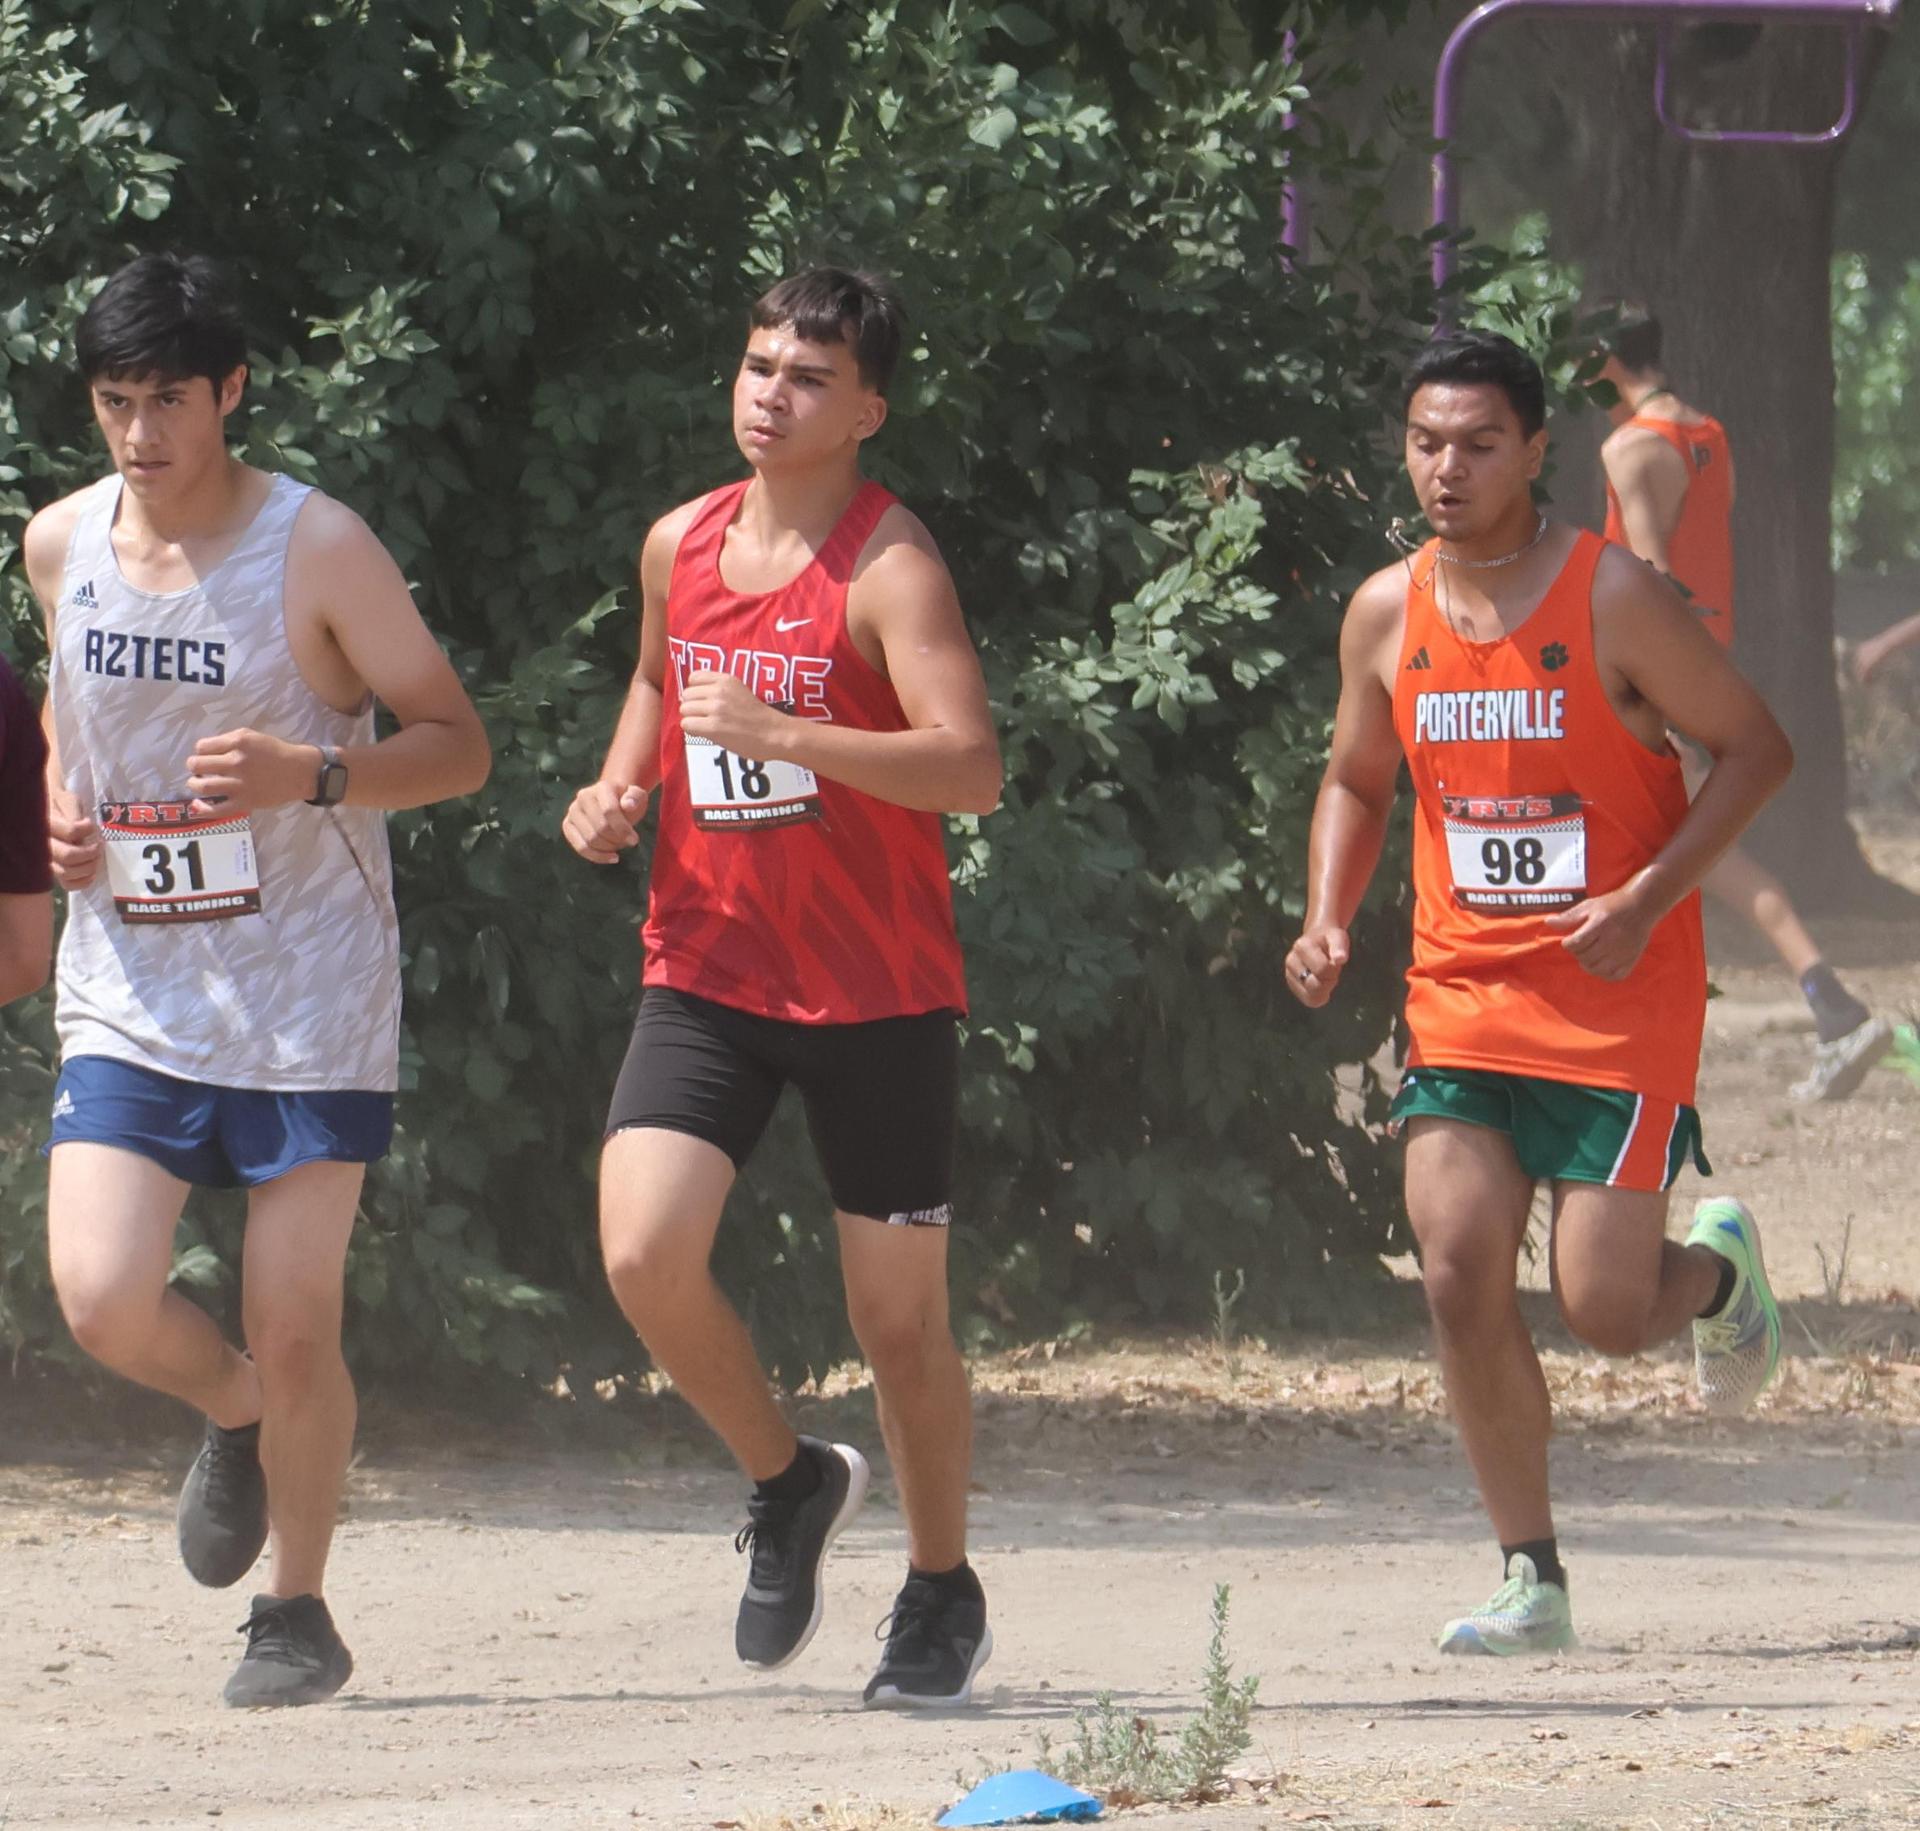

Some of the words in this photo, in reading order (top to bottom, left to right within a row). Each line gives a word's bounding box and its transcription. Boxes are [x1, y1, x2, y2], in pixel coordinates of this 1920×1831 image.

[85, 628, 226, 686] AZTECS
[1415, 689, 1564, 743] PORTERVILLE
[714, 749, 771, 801] 18
[704, 809, 740, 821] RACE
[741, 802, 807, 819] TIMING
[1468, 799, 1553, 818] RTS
[142, 840, 206, 895] 31
[1481, 837, 1546, 886] 98
[127, 902, 172, 913] RACE
[174, 896, 246, 913] TIMING
[1466, 892, 1507, 904] RACE
[1508, 892, 1574, 905] TIMING
